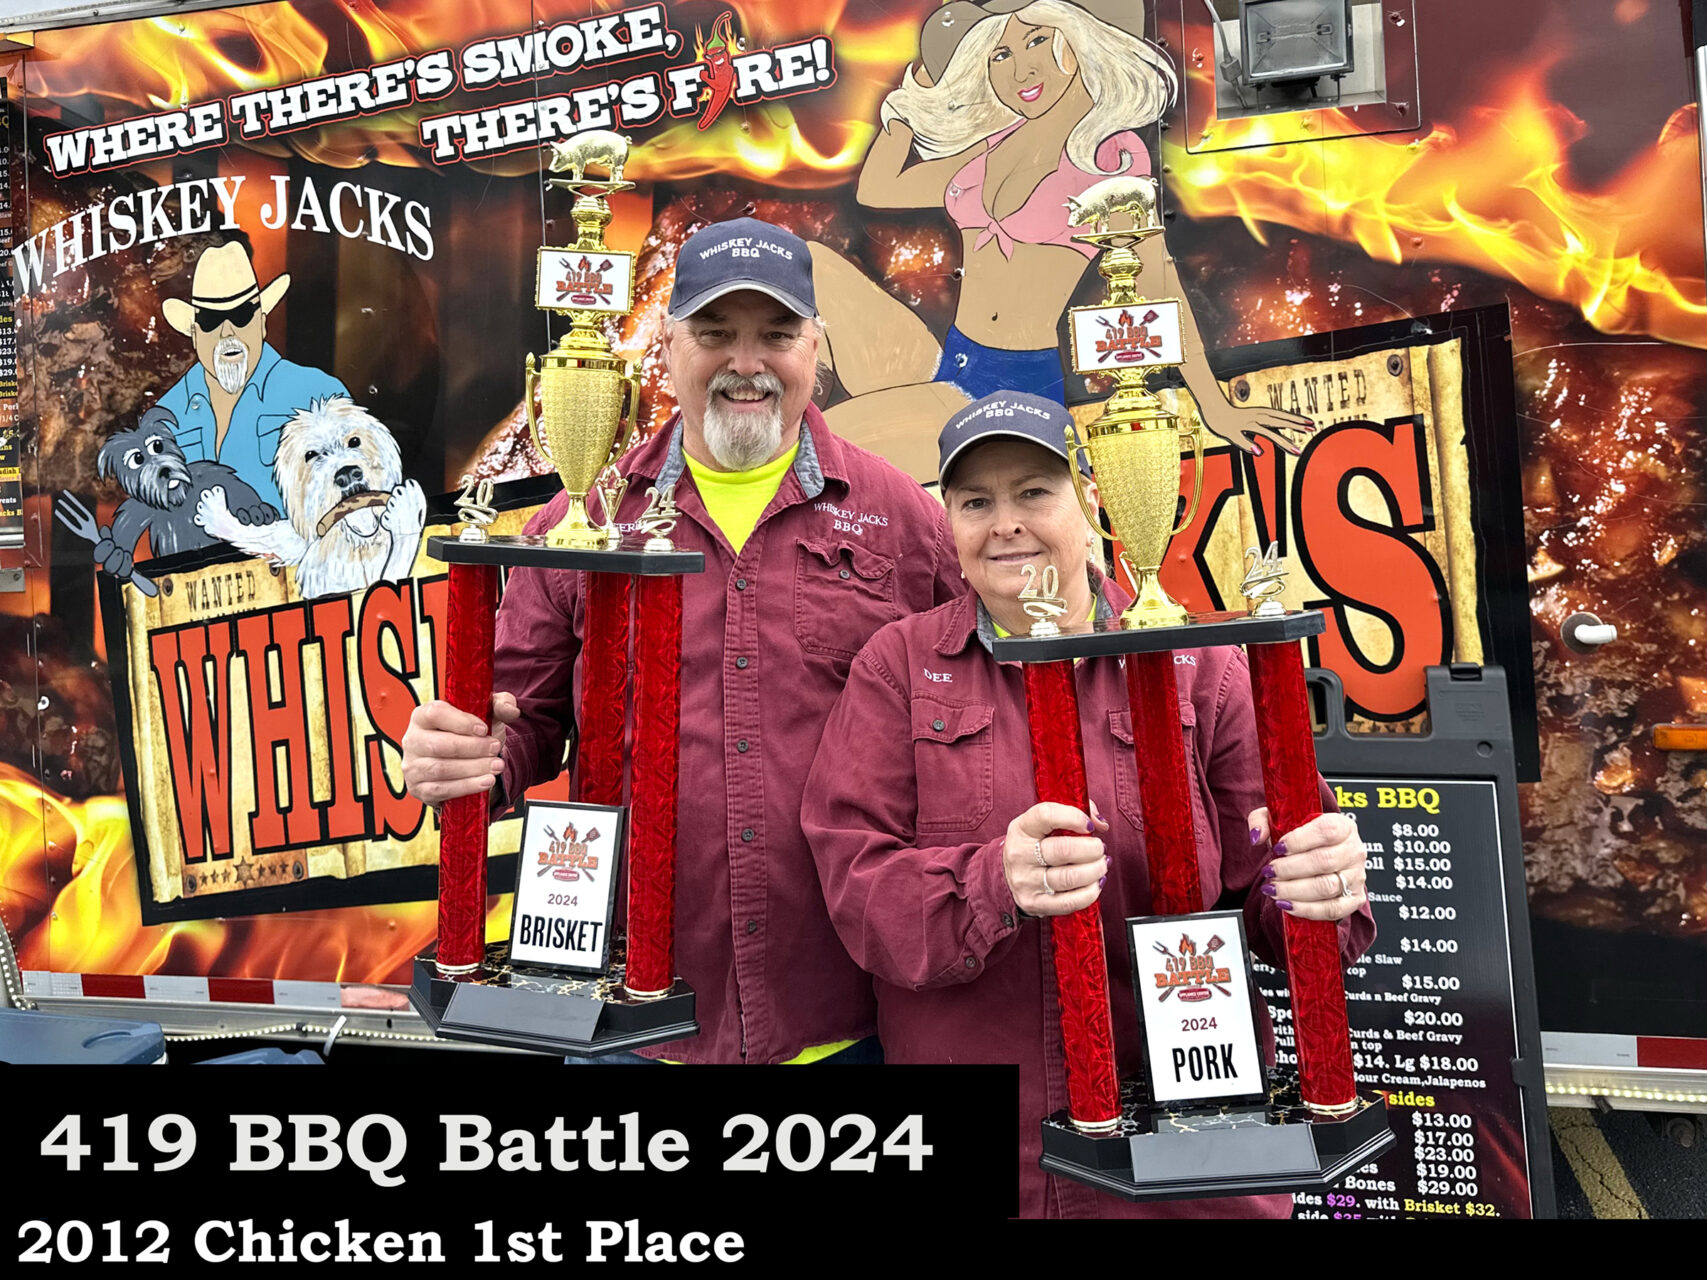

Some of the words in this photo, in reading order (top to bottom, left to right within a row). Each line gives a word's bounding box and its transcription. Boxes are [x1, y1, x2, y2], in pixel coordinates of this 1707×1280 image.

[48, 111, 223, 172] WHERE
[232, 52, 451, 138] THERE'S
[463, 8, 678, 87] SMOKE,
[424, 76, 657, 161] THERE'S
[10, 176, 245, 297] WHISKEY
[259, 175, 436, 262] JACKS
[699, 237, 753, 260] WHISKEY
[755, 239, 794, 261] JACKS
[731, 248, 760, 258] BBQ
[555, 279, 614, 296] BATTLE
[1095, 335, 1163, 352] BATTLE
[1267, 369, 1367, 415] WANTED
[956, 400, 1007, 430] WHISKEY
[1010, 402, 1051, 420] JACKS
[454, 474, 495, 507] 20
[643, 483, 677, 518] 24
[814, 502, 855, 520] WHISKEY
[857, 512, 889, 527] JACKS
[833, 519, 863, 535] BBQ
[1018, 564, 1060, 600] 20
[185, 570, 256, 613] WANTED
[924, 668, 953, 683] DEE
[149, 574, 448, 864] WHIS
[1376, 787, 1440, 814] BBQ
[1392, 822, 1440, 837] $8.00
[1393, 838, 1451, 855] $10.00
[537, 852, 599, 870] BATTLE
[1393, 855, 1451, 871] $15.00
[1396, 875, 1453, 891] $14.00
[547, 893, 578, 907] 2024
[1367, 892, 1402, 902] Sauce
[1399, 904, 1457, 920] $12.00
[519, 913, 603, 952] BRISKET
[1400, 937, 1458, 953] $14.00
[1375, 954, 1403, 965] Slaw
[1154, 967, 1232, 988] BATTLE
[1402, 974, 1460, 991] $15.00
[1384, 992, 1409, 1003] Beef
[1410, 994, 1442, 1006] Gravy
[1181, 1017, 1218, 1031] 2024
[1404, 1009, 1463, 1026] $20.00
[1383, 1029, 1394, 1040] &
[1396, 1029, 1425, 1041] Beef
[1426, 1031, 1463, 1045] Gravy
[1361, 1040, 1383, 1053] top
[1172, 1043, 1238, 1082] PORK
[1353, 1052, 1390, 1069] $14.
[1395, 1055, 1415, 1072] Lg
[1419, 1056, 1479, 1072] $18.00
[1389, 1091, 1435, 1107] sides
[1412, 1111, 1472, 1128] $13.00
[1414, 1130, 1474, 1147] $17.00
[1414, 1146, 1475, 1163] $23.00
[1416, 1162, 1477, 1180] $19.00
[1344, 1175, 1396, 1192] Bones
[1417, 1178, 1478, 1196] $29.00
[1365, 1196, 1400, 1211] with
[1404, 1198, 1460, 1215] Brisket
